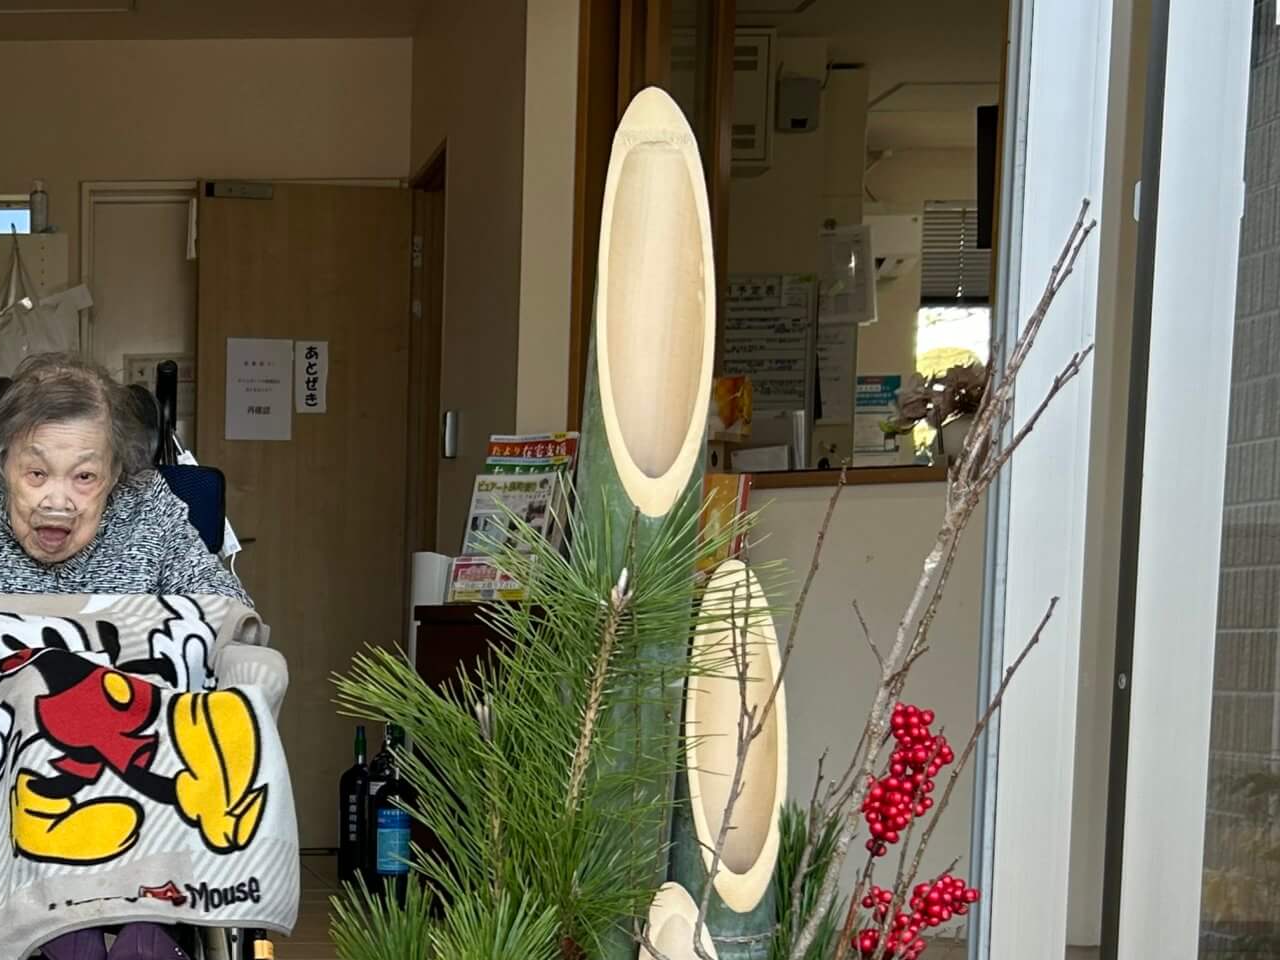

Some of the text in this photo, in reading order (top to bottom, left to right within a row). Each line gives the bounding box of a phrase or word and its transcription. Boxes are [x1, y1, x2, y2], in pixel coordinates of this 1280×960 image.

[304, 345, 319, 408] あとぜき
[184, 876, 261, 913] Mouse
